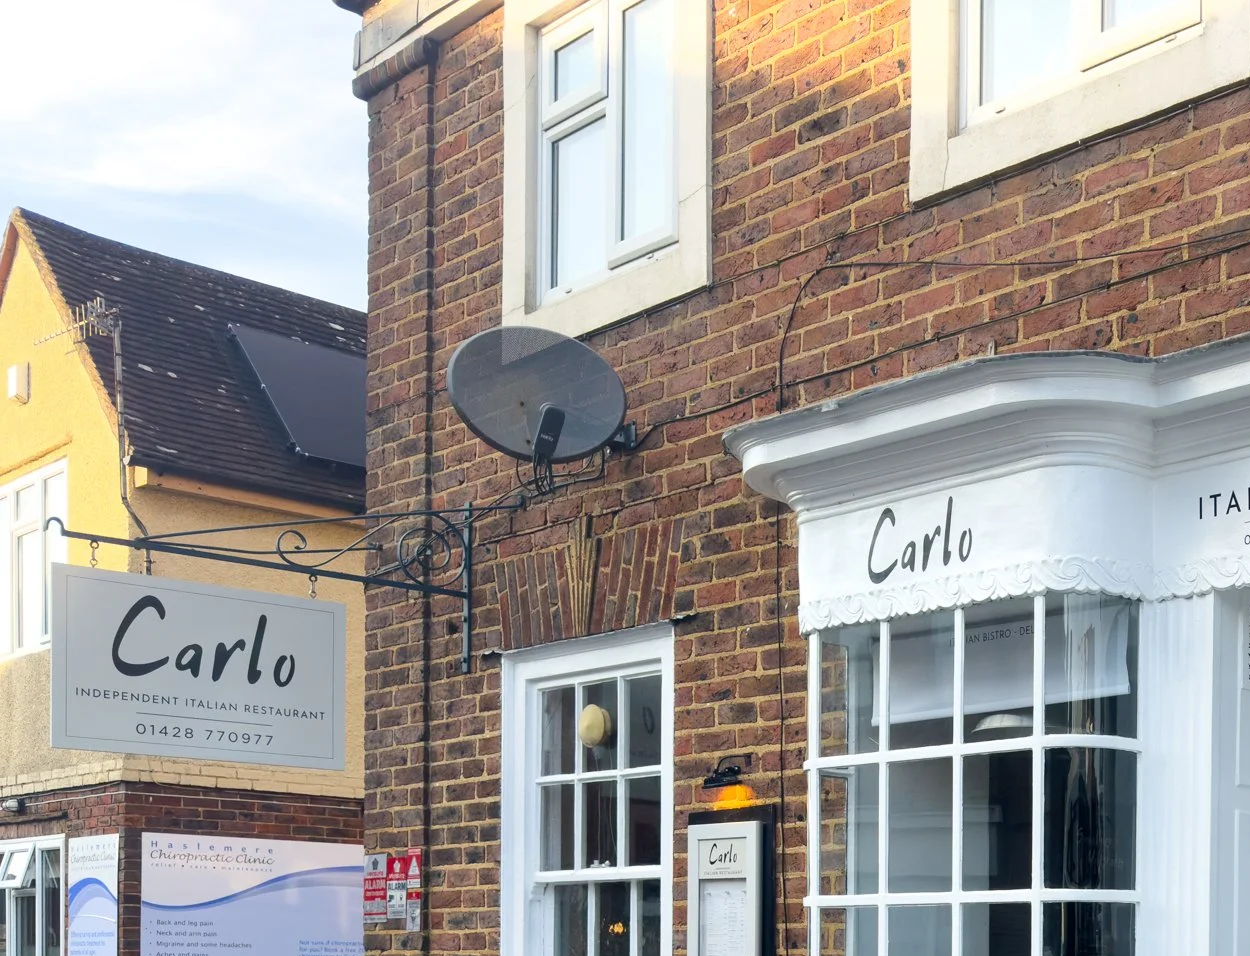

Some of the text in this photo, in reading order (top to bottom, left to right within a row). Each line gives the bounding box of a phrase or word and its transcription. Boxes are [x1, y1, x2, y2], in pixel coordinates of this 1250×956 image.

[868, 496, 972, 584] Carlo
[112, 595, 296, 687] Carlo
[982, 628, 1011, 642] BISTRO
[1019, 625, 1035, 636] DEL
[75, 687, 326, 720] INDEPENDENT ITALIAN RESTAURANT
[135, 723, 274, 746] 01428 770977
[150, 840, 274, 854] Haslemere
[709, 843, 738, 865] Carlo
[150, 849, 275, 865] Chiropractic Clinic
[365, 879, 386, 889] ALARM
[388, 882, 406, 890] ALARM
[187, 919, 198, 927] leg
[156, 940, 185, 948] Migraine
